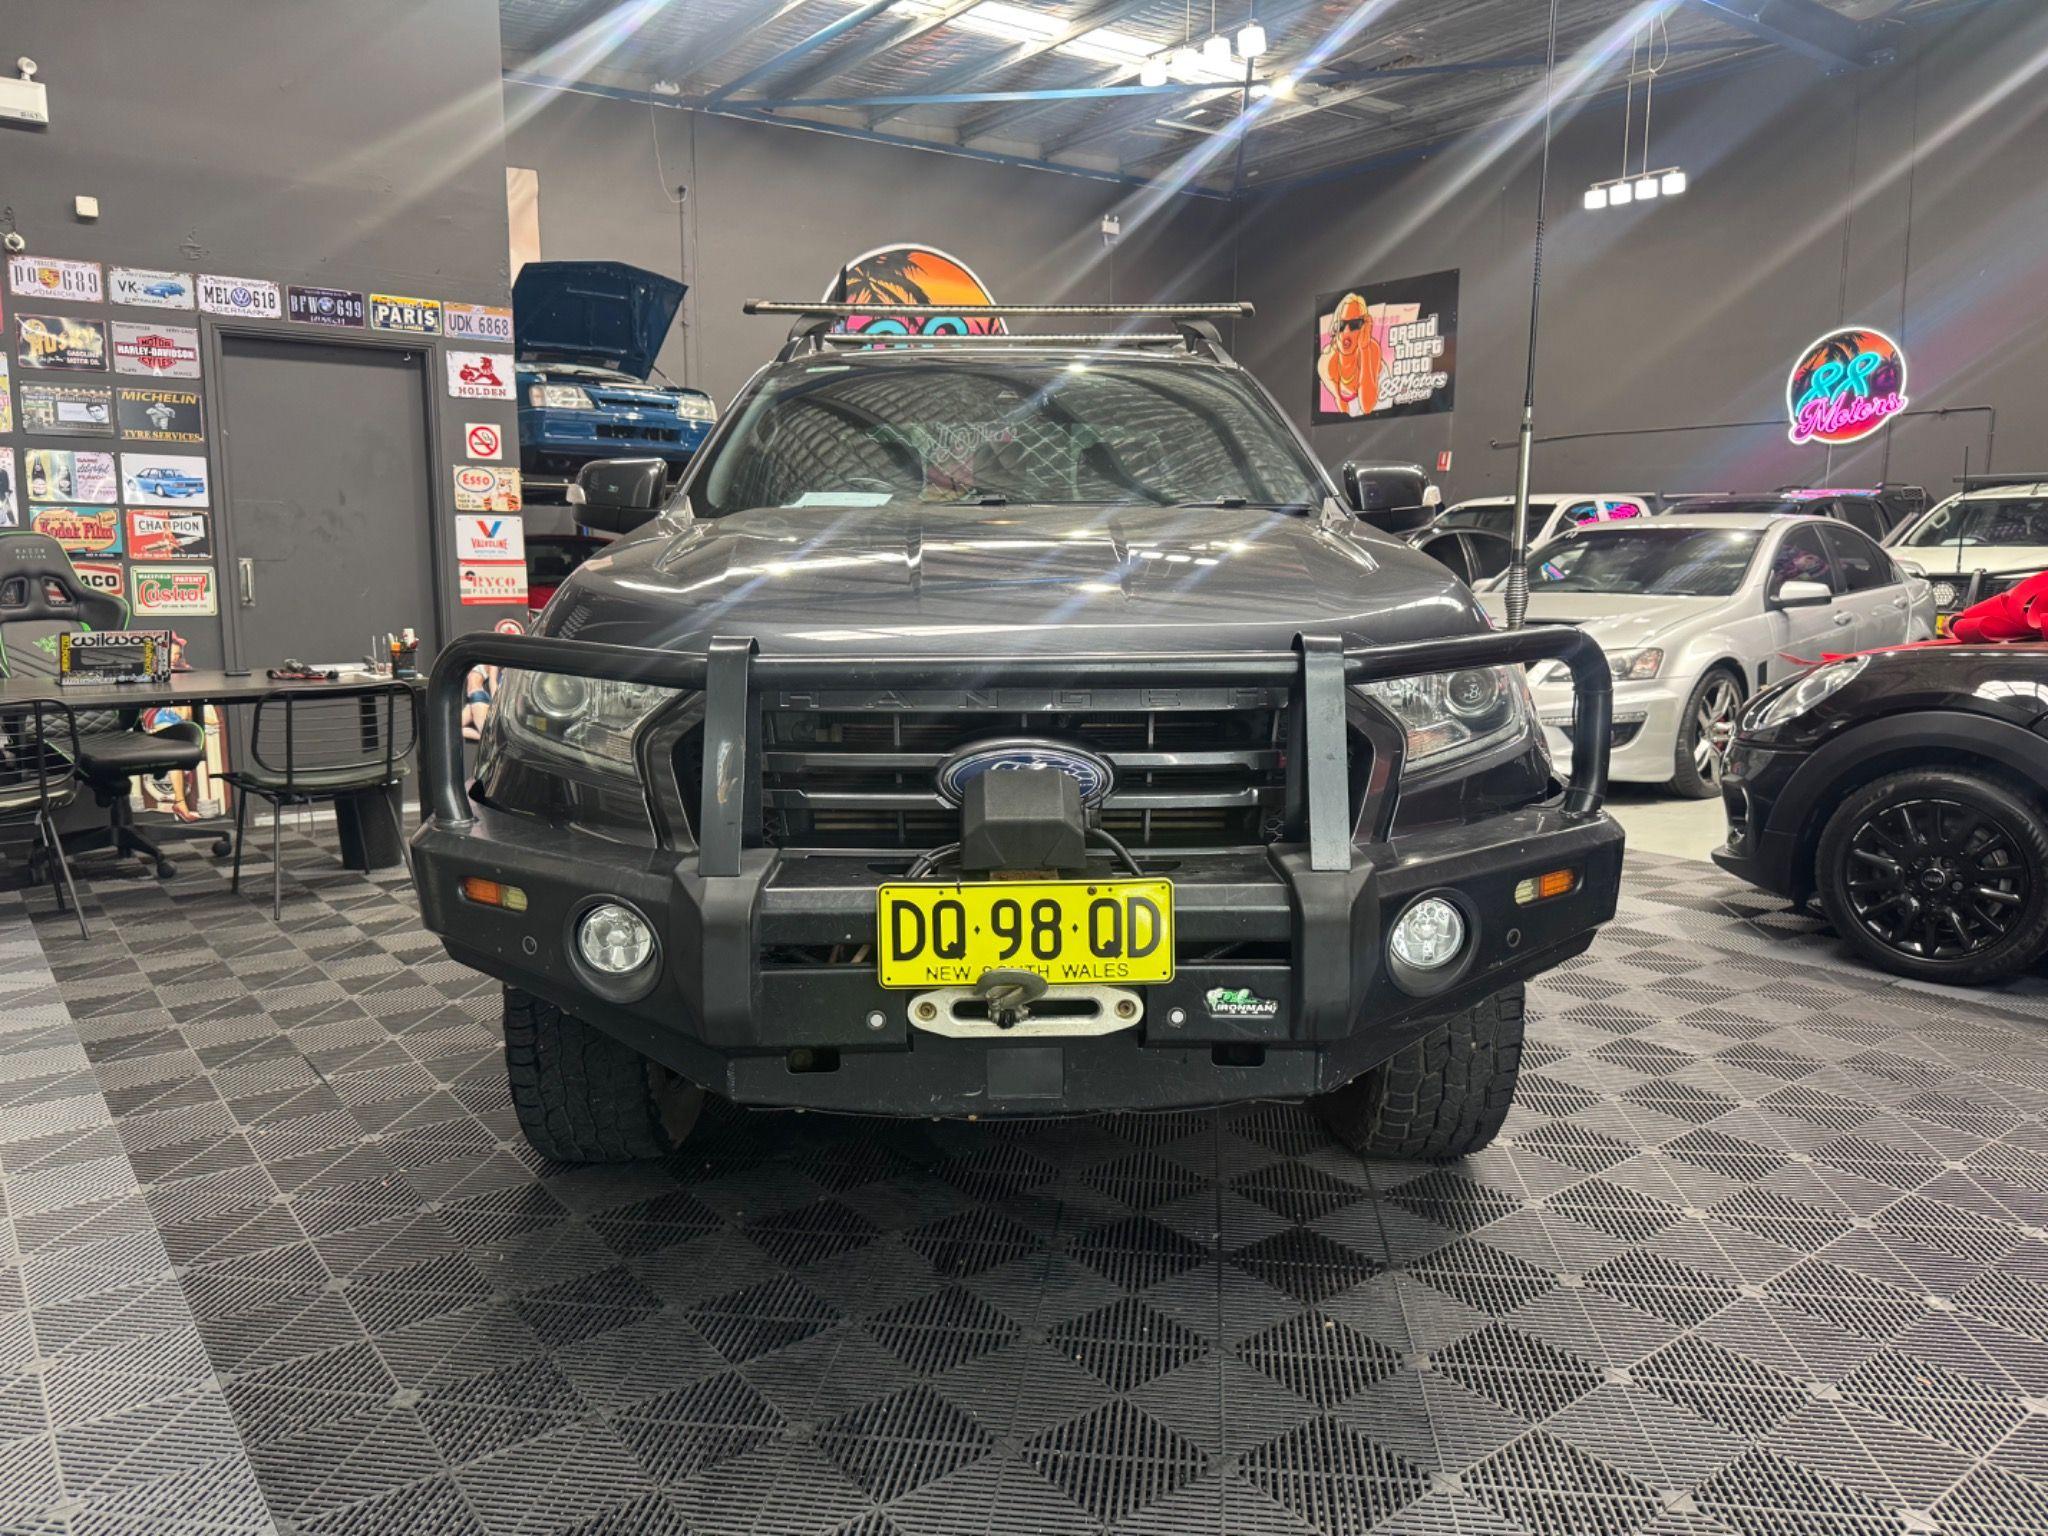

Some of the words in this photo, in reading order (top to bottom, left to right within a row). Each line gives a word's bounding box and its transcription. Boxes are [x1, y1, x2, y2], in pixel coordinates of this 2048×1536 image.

[62, 269, 98, 294] 689
[204, 285, 231, 305] MEL
[253, 290, 276, 309] 618
[336, 299, 362, 318] 699
[377, 304, 436, 328] PARIS
[448, 314, 473, 332] UDK
[478, 316, 509, 336] 6868
[1389, 315, 1437, 346] grand
[116, 344, 195, 359] HARLEY-DAVIDSON
[1395, 338, 1442, 360] theft
[1393, 357, 1431, 376] auto
[458, 387, 507, 397] HOLDEN
[1795, 351, 1881, 418] 88
[121, 391, 198, 405] MICHELIN
[1794, 391, 1904, 440] Motors
[124, 430, 151, 439] TYRE
[152, 431, 200, 440] SERVICES
[39, 517, 82, 538] Kodak
[82, 520, 114, 539] Film
[471, 538, 508, 549] VALVOLINE
[140, 575, 207, 608] Castrol
[472, 576, 516, 588] RYCO
[71, 631, 169, 648] wilwood
[926, 965, 972, 981] NEW
[1062, 962, 1130, 979] WALES
